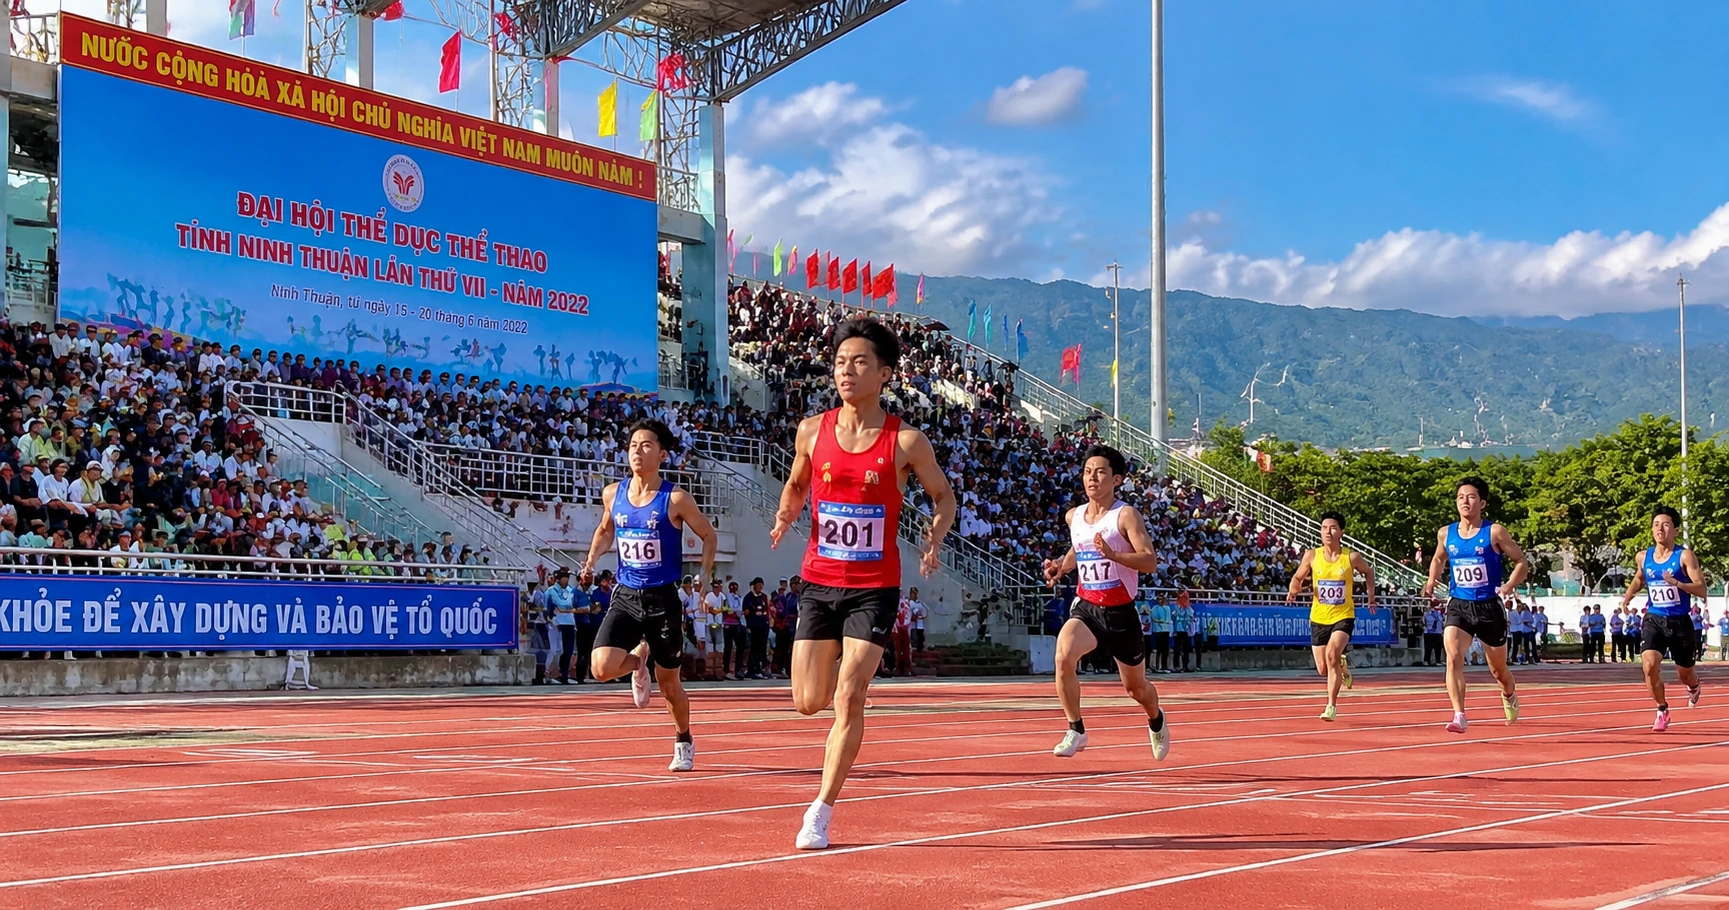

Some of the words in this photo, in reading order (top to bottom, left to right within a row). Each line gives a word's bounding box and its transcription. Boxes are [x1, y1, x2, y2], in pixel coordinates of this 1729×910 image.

[545, 148, 593, 177] MUÔN
[237, 191, 283, 227] ĐẠI
[394, 222, 440, 256] DỤC
[493, 242, 547, 273] THAO
[238, 234, 293, 265] NINH
[461, 274, 485, 298] VII
[548, 290, 589, 315] 2022
[419, 307, 432, 320] 20
[468, 314, 474, 326] 6
[503, 319, 528, 333] 2022
[824, 519, 873, 547] 201
[622, 542, 655, 560] 216
[1080, 561, 1110, 581] 217
[1456, 567, 1483, 582] 209
[1320, 587, 1343, 598] 203
[1651, 588, 1675, 602] 210
[0, 587, 73, 633] KHỎE
[83, 587, 121, 633] ĐỂ
[131, 594, 186, 633] XÂY
[195, 600, 267, 640] DỰNG
[316, 595, 363, 634] BẢO
[371, 599, 399, 640] VỆ
[406, 594, 432, 635] TỔ
[440, 597, 497, 638] QUỐC
